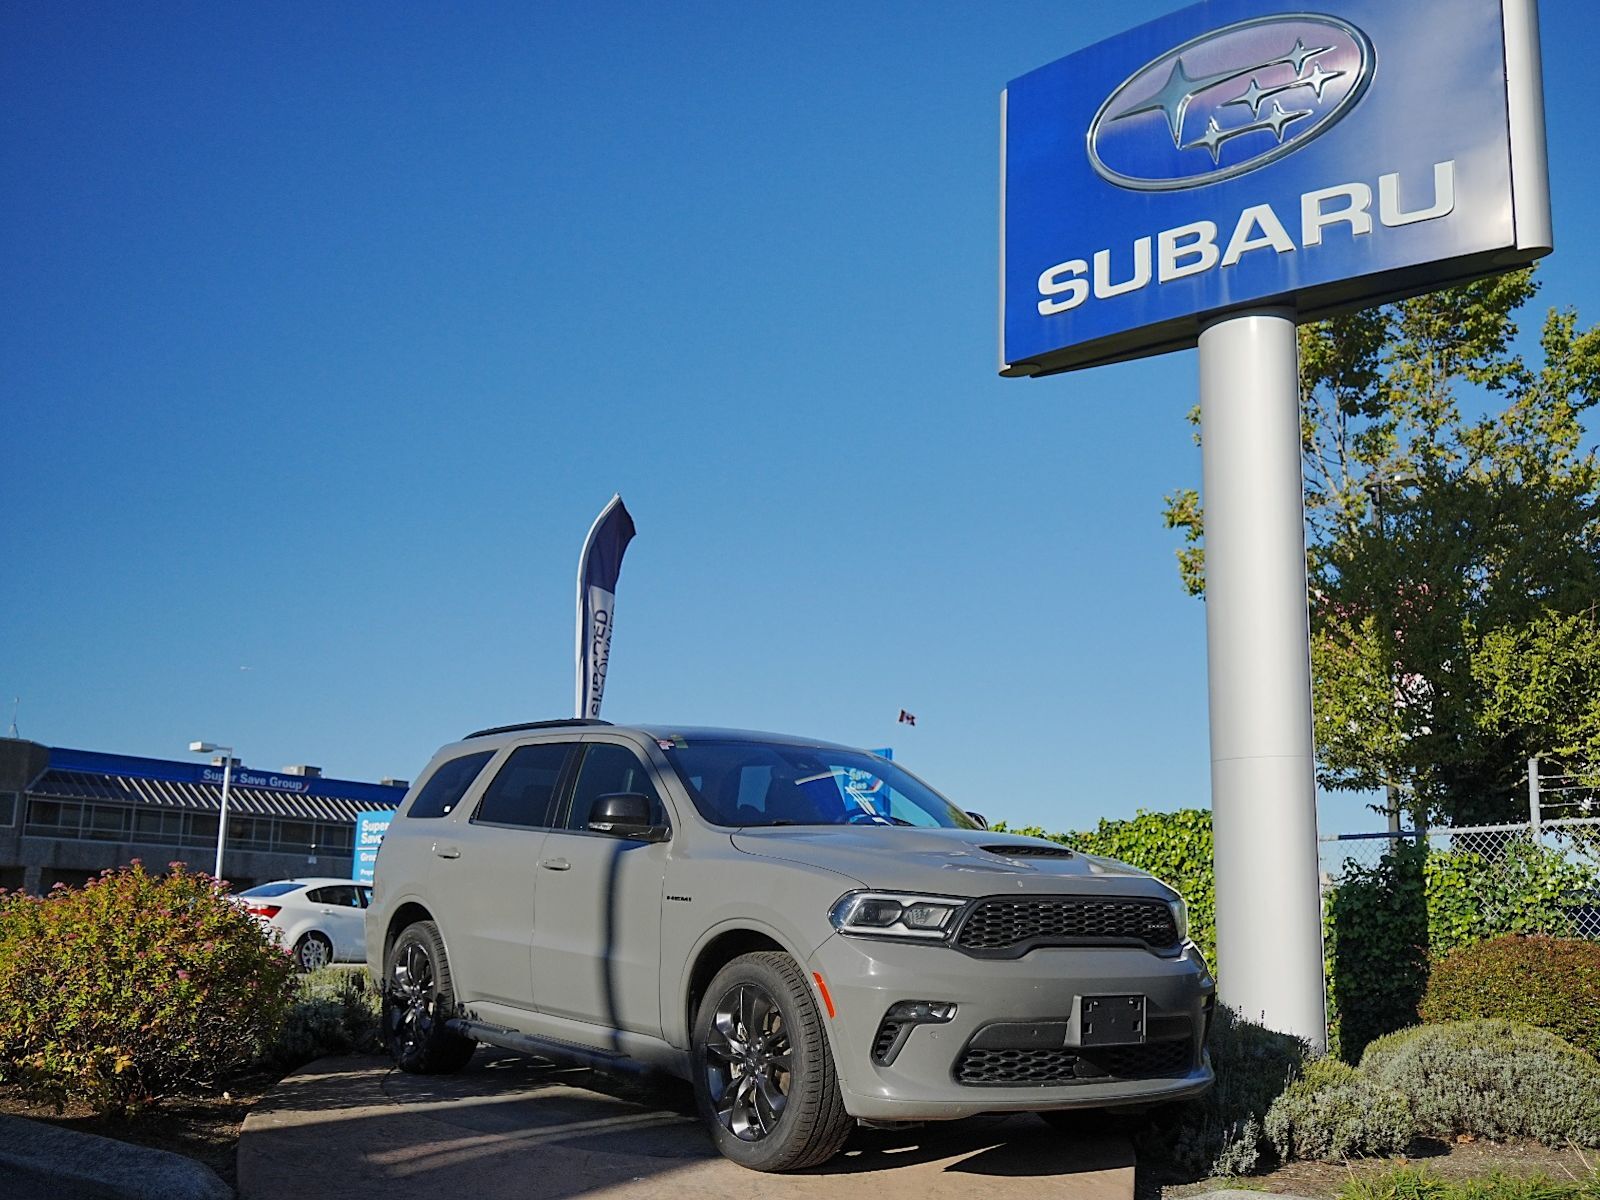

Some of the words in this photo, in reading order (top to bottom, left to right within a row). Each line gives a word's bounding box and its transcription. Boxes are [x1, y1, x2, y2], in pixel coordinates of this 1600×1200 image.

[1037, 160, 1456, 317] SUBARU
[203, 769, 237, 786] Supr
[240, 773, 267, 787] Save
[269, 776, 303, 793] Group
[361, 819, 390, 833] Super
